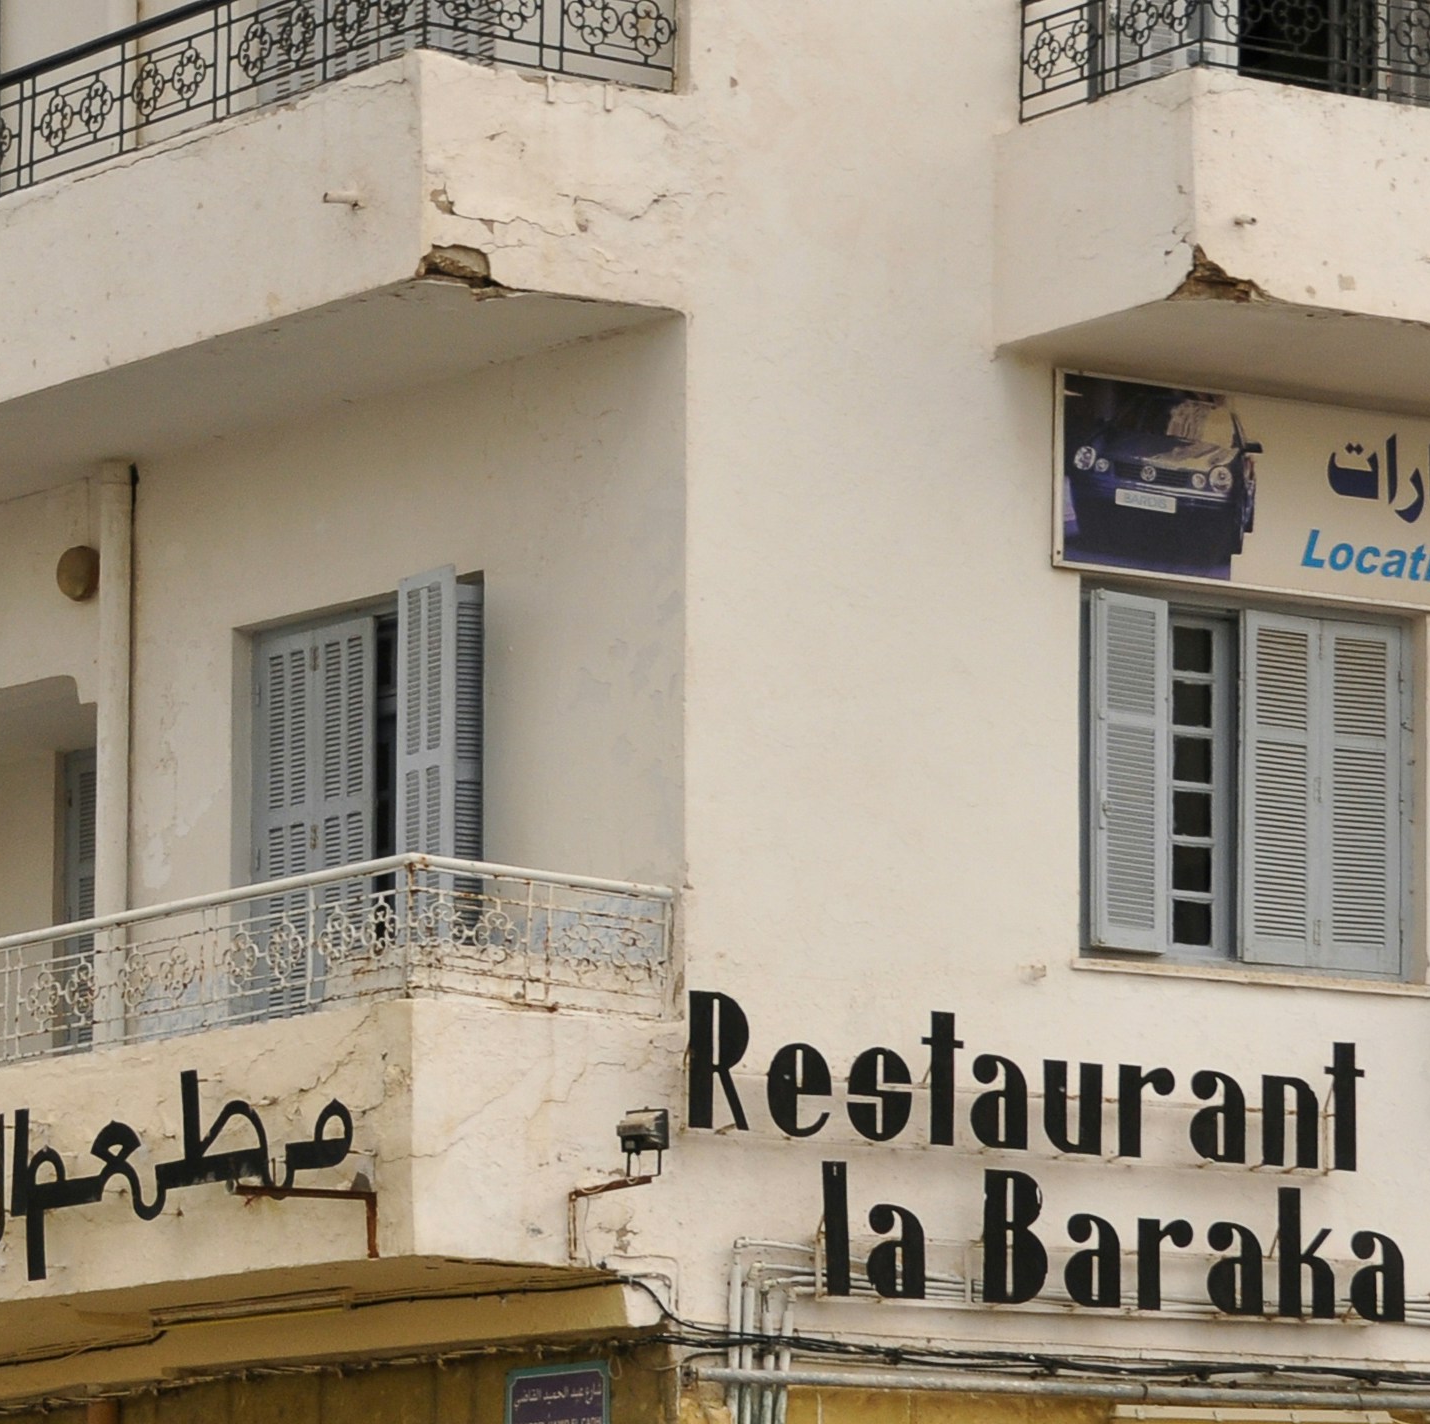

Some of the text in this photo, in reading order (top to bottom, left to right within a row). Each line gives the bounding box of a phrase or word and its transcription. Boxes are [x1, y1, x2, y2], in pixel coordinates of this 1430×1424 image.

[688, 990, 1365, 1171] Restaurant
[26, 1069, 354, 1280] مطعم
[822, 1161, 1405, 1323] la Baraka
